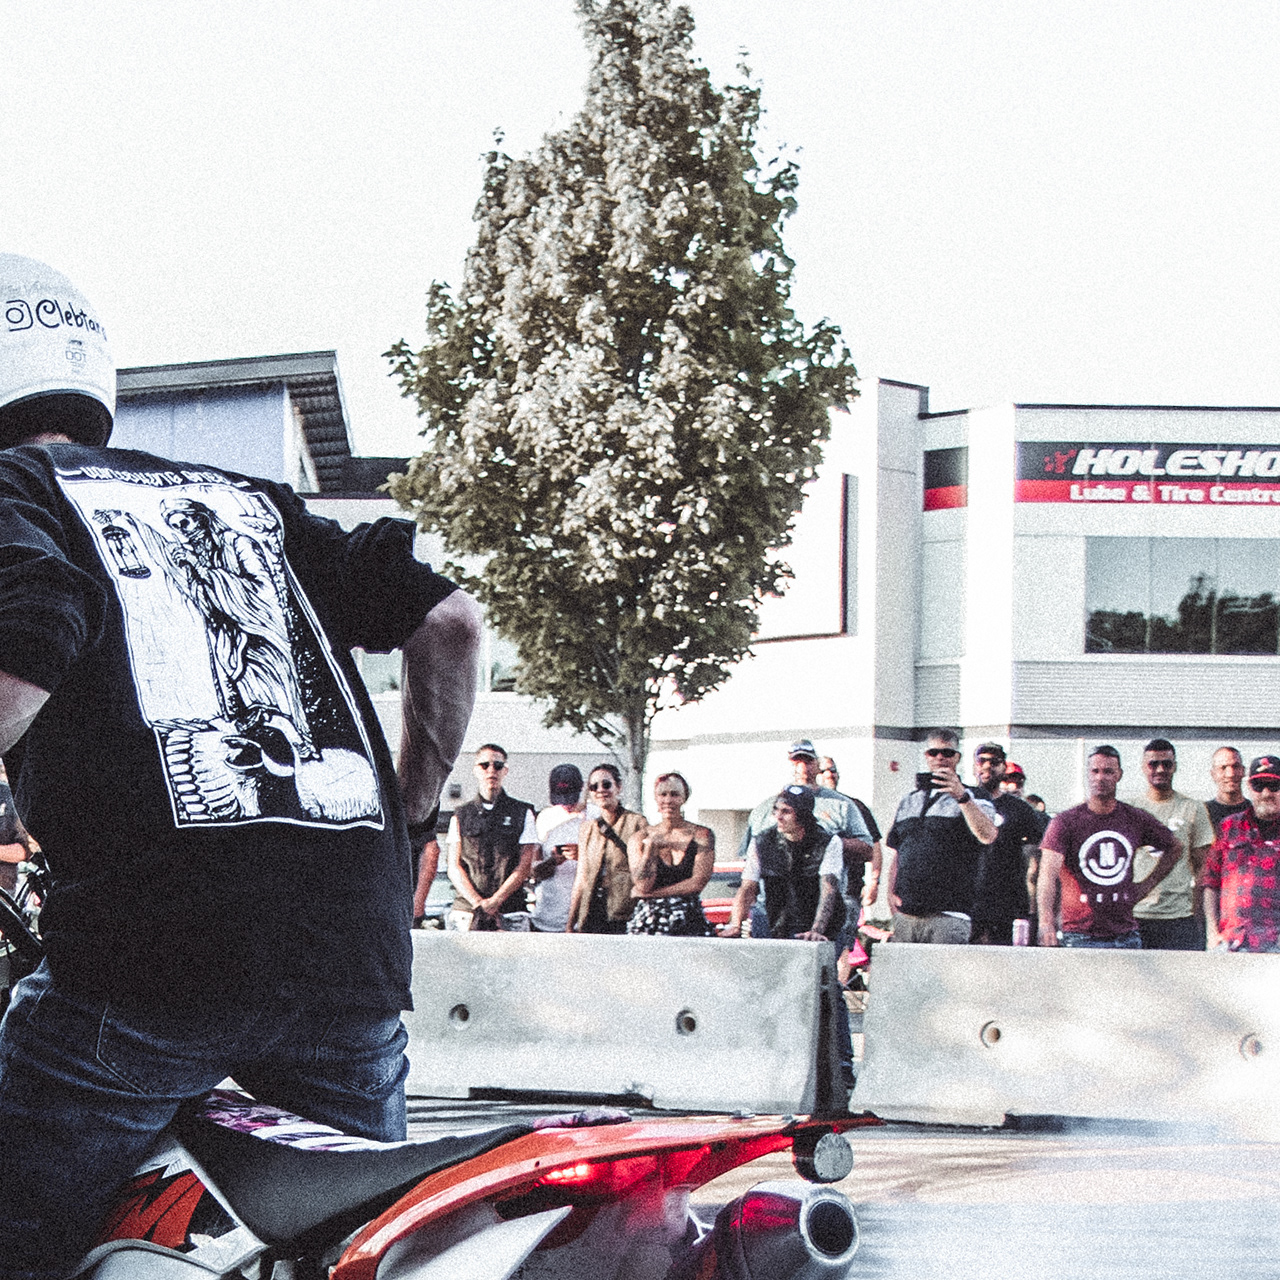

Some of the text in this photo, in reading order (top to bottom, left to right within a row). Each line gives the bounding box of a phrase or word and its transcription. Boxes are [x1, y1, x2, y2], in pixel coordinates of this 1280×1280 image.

[1070, 484, 1126, 501] Lube
[1132, 484, 1153, 501] &
[1157, 484, 1205, 502] Tire
